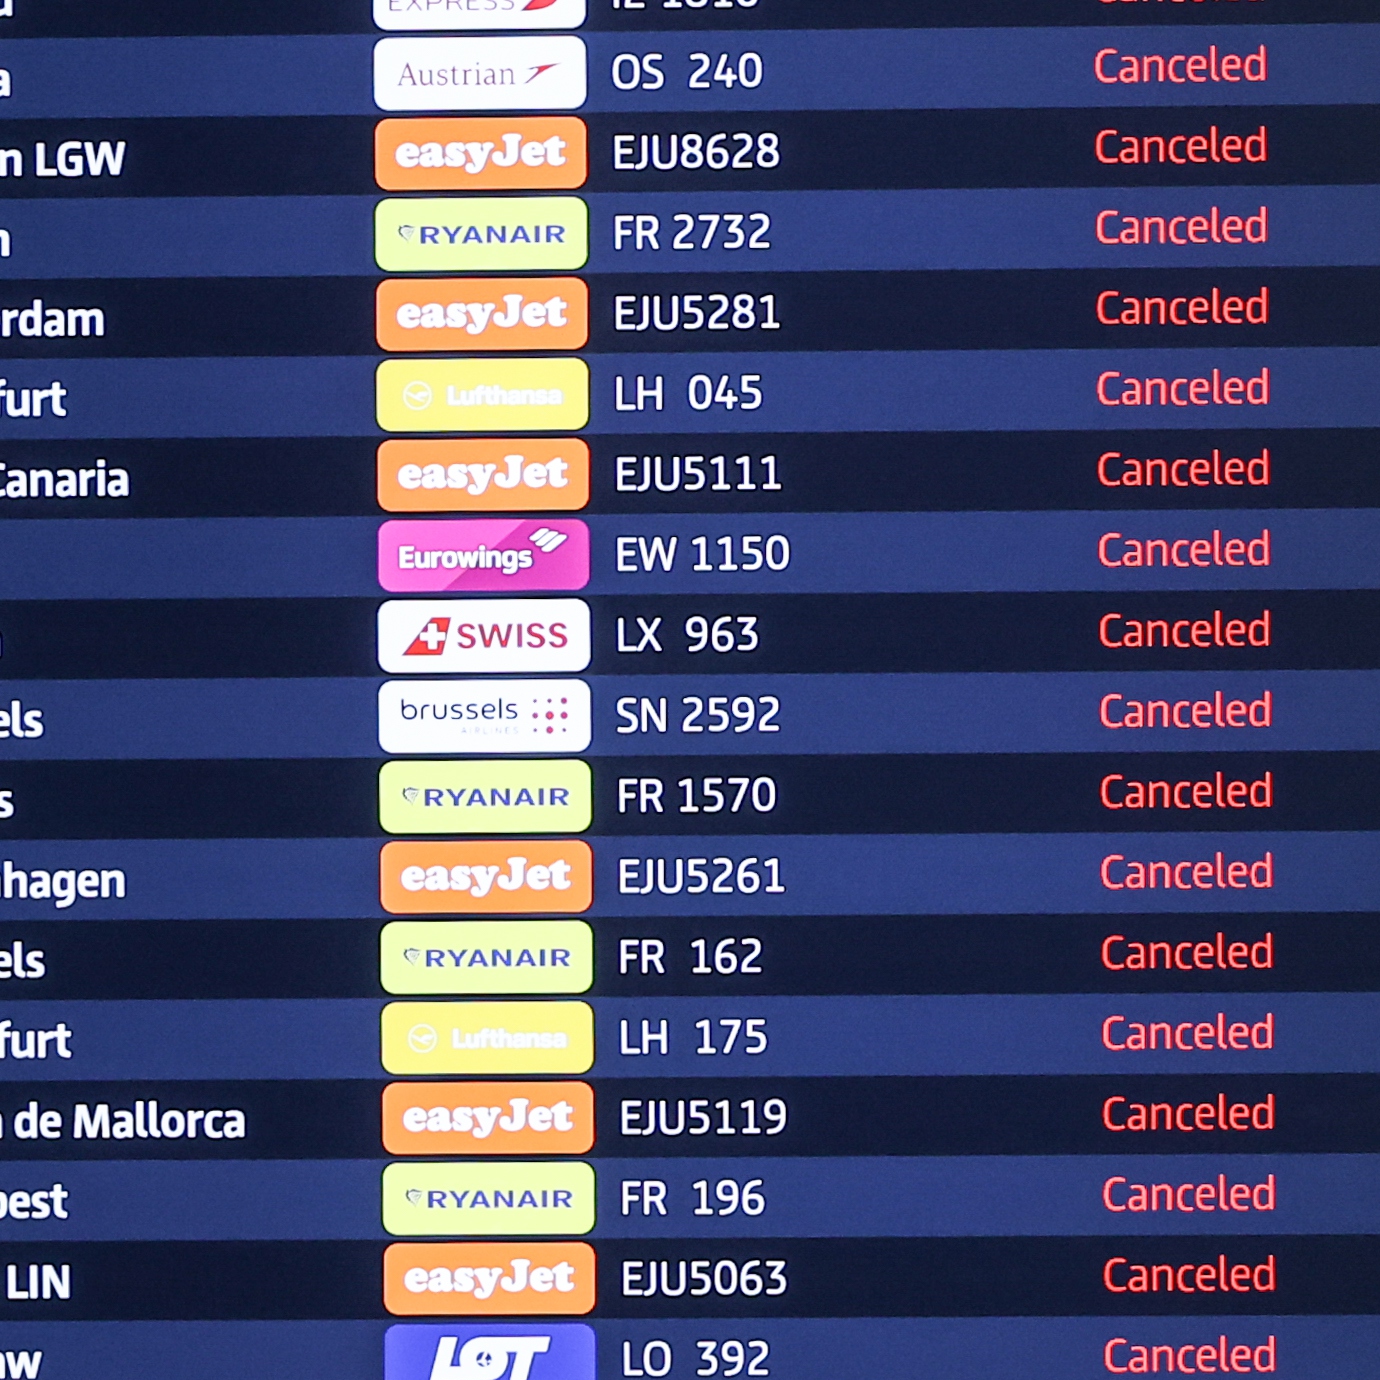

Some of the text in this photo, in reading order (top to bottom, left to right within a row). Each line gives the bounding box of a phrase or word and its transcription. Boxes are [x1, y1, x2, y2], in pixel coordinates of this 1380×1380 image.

[399, 63, 514, 86] Austrian
[613, 53, 762, 89] OS 240
[36, 141, 125, 176] LGW
[396, 134, 566, 173] easyJet
[1095, 126, 1267, 164] Canceled
[421, 226, 564, 243] RYANAIR
[615, 214, 769, 249] FR 2732
[616, 375, 761, 410] LH 045
[400, 545, 532, 574] Eurowings
[617, 535, 789, 571] EW 1150
[1098, 529, 1270, 568] Canceled
[458, 623, 567, 648] SWISS
[401, 699, 517, 720] brussels
[617, 697, 779, 733] SN 2592
[620, 858, 784, 894] EJU5261
[1101, 932, 1273, 970] Canceled
[14, 1101, 244, 1138] de Mallorca
[8, 1265, 69, 1299] LIN
[1103, 1255, 1276, 1293] Canceled
[624, 1341, 768, 1376] LO 392
